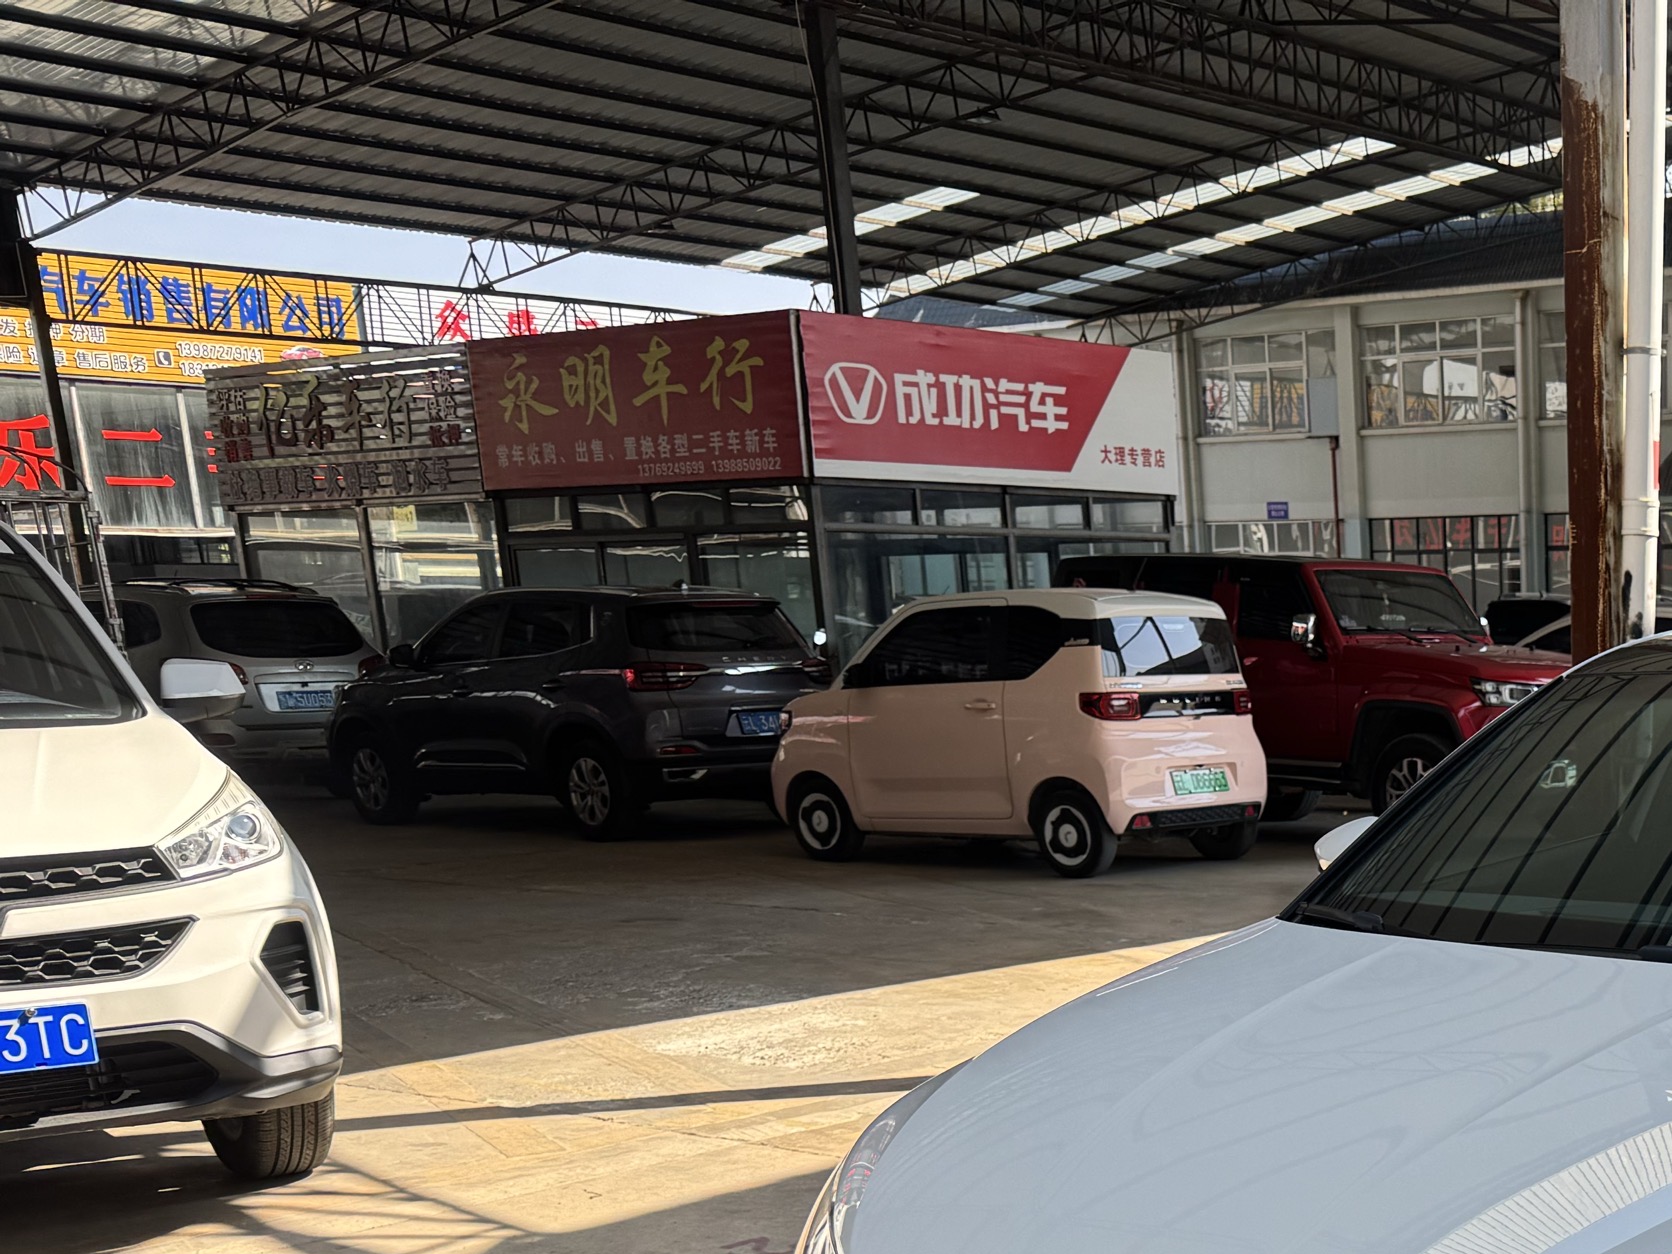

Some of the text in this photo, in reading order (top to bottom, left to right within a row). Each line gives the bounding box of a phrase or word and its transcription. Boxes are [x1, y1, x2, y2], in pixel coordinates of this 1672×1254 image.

[75, 349, 148, 372] 售后服务
[176, 341, 264, 363] 13987279141
[498, 335, 764, 434] 永明车行
[894, 369, 1069, 434] 成功汽车
[1100, 445, 1165, 468] 大理专营店
